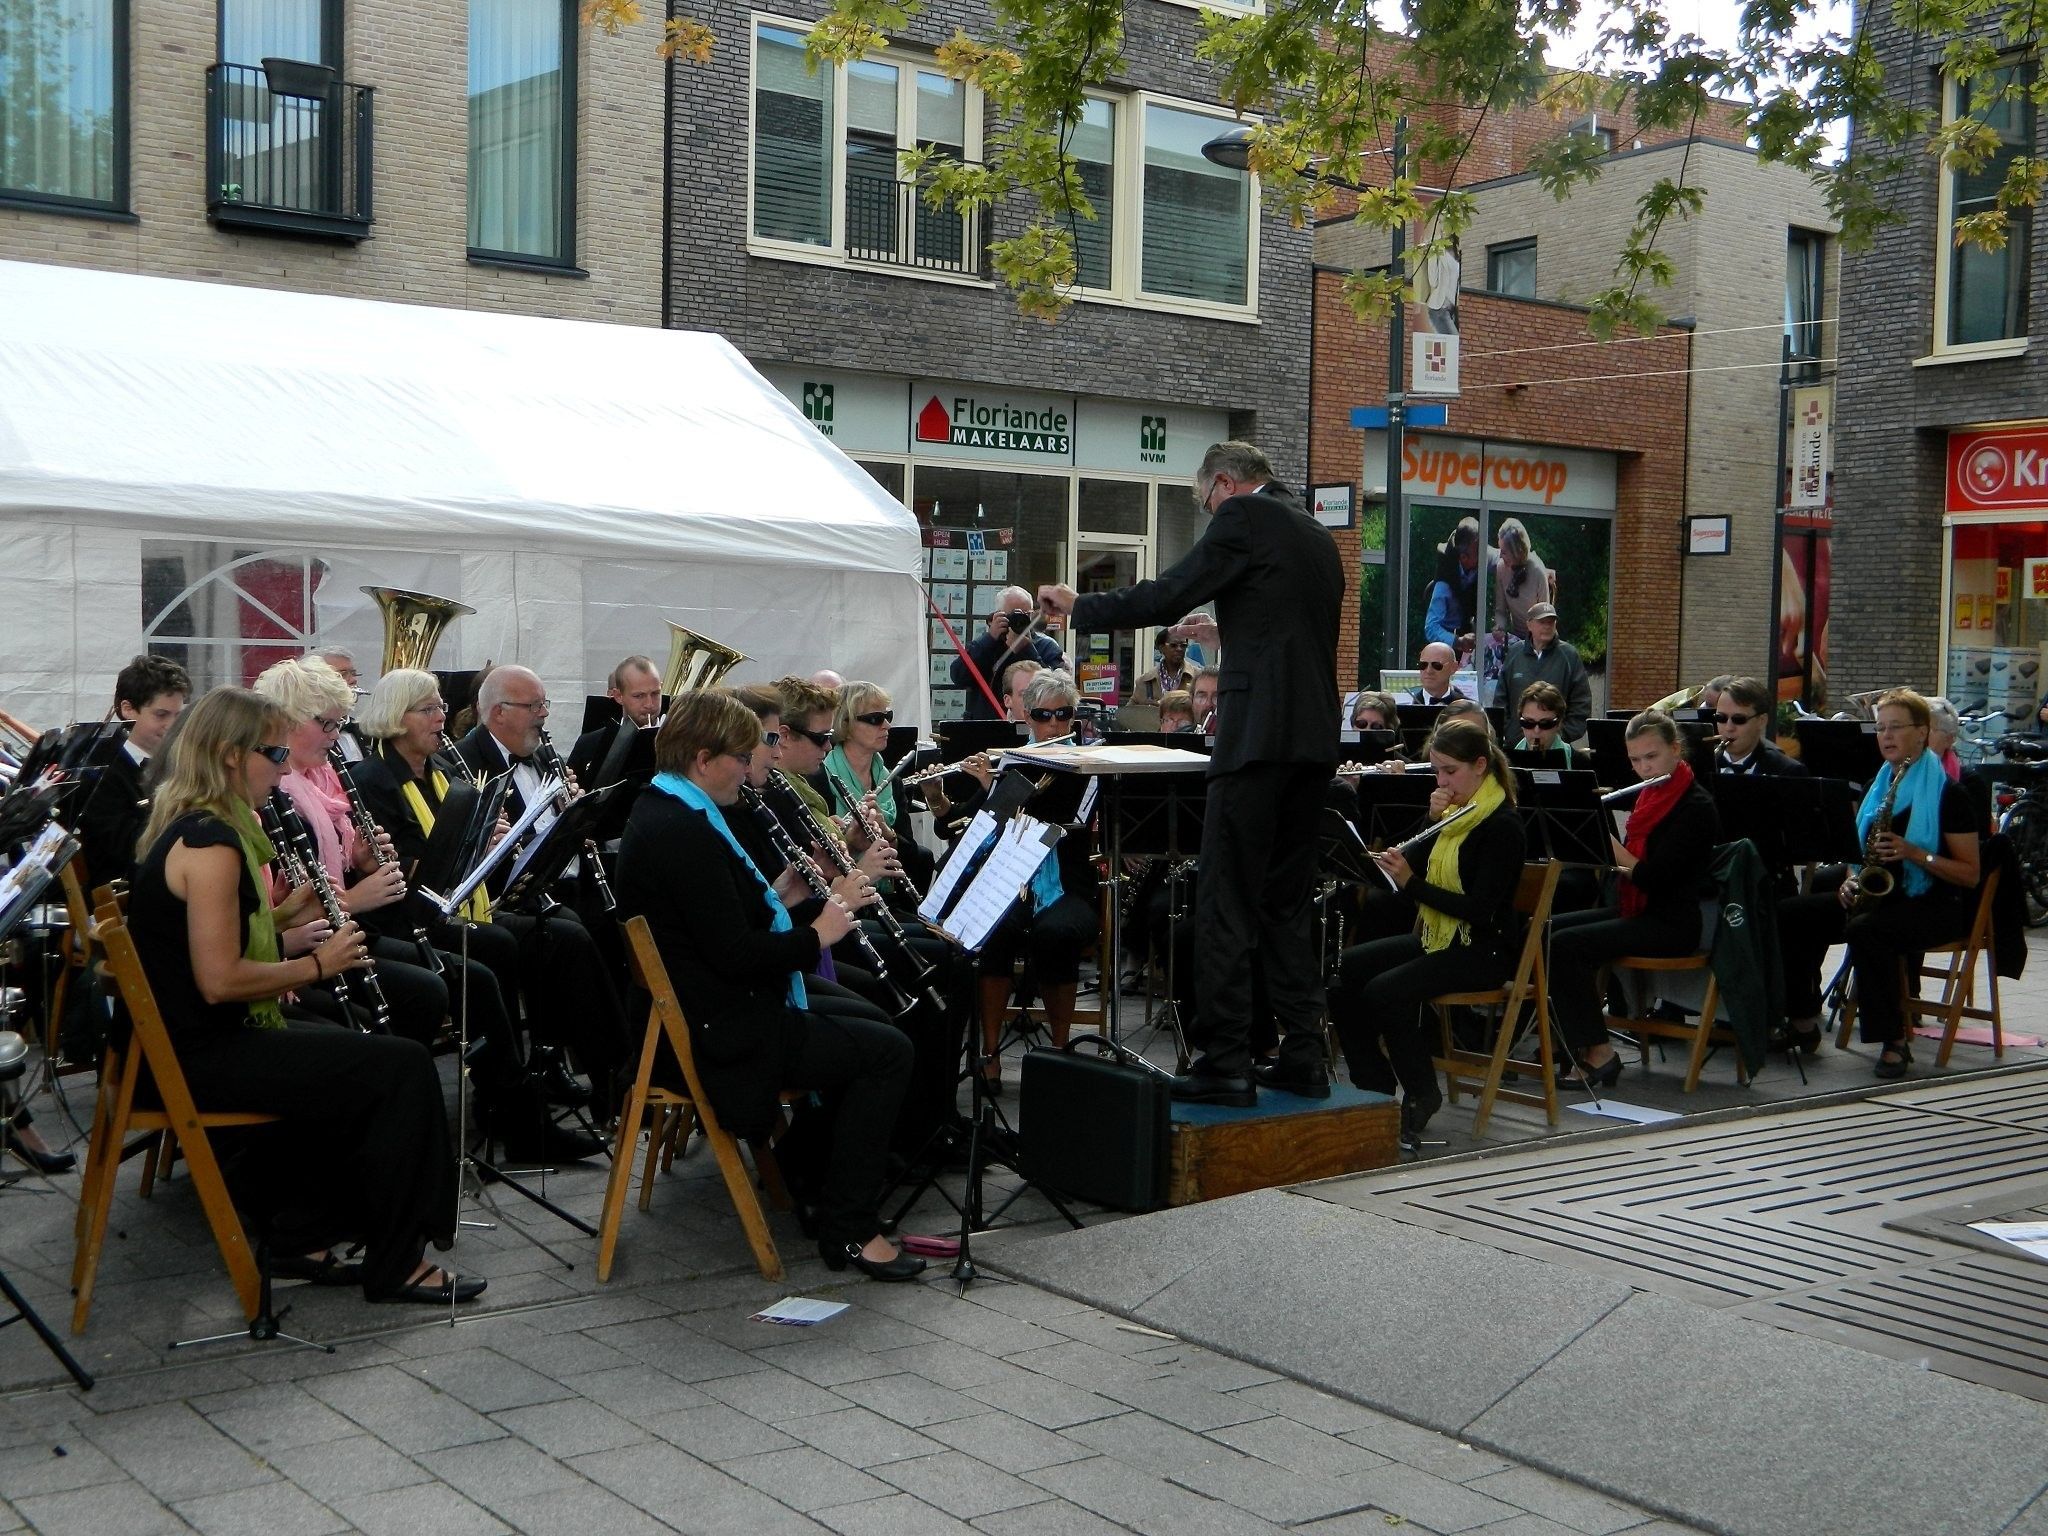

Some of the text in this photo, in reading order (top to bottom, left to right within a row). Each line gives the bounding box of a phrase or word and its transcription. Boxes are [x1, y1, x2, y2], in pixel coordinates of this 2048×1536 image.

[953, 397, 1068, 432] Floriande
[814, 423, 834, 436] VM
[953, 428, 1068, 453] MAKELAARS
[1140, 452, 1166, 464] NVM
[1402, 435, 1568, 505] Supercoop
[932, 530, 951, 538] OPEN
